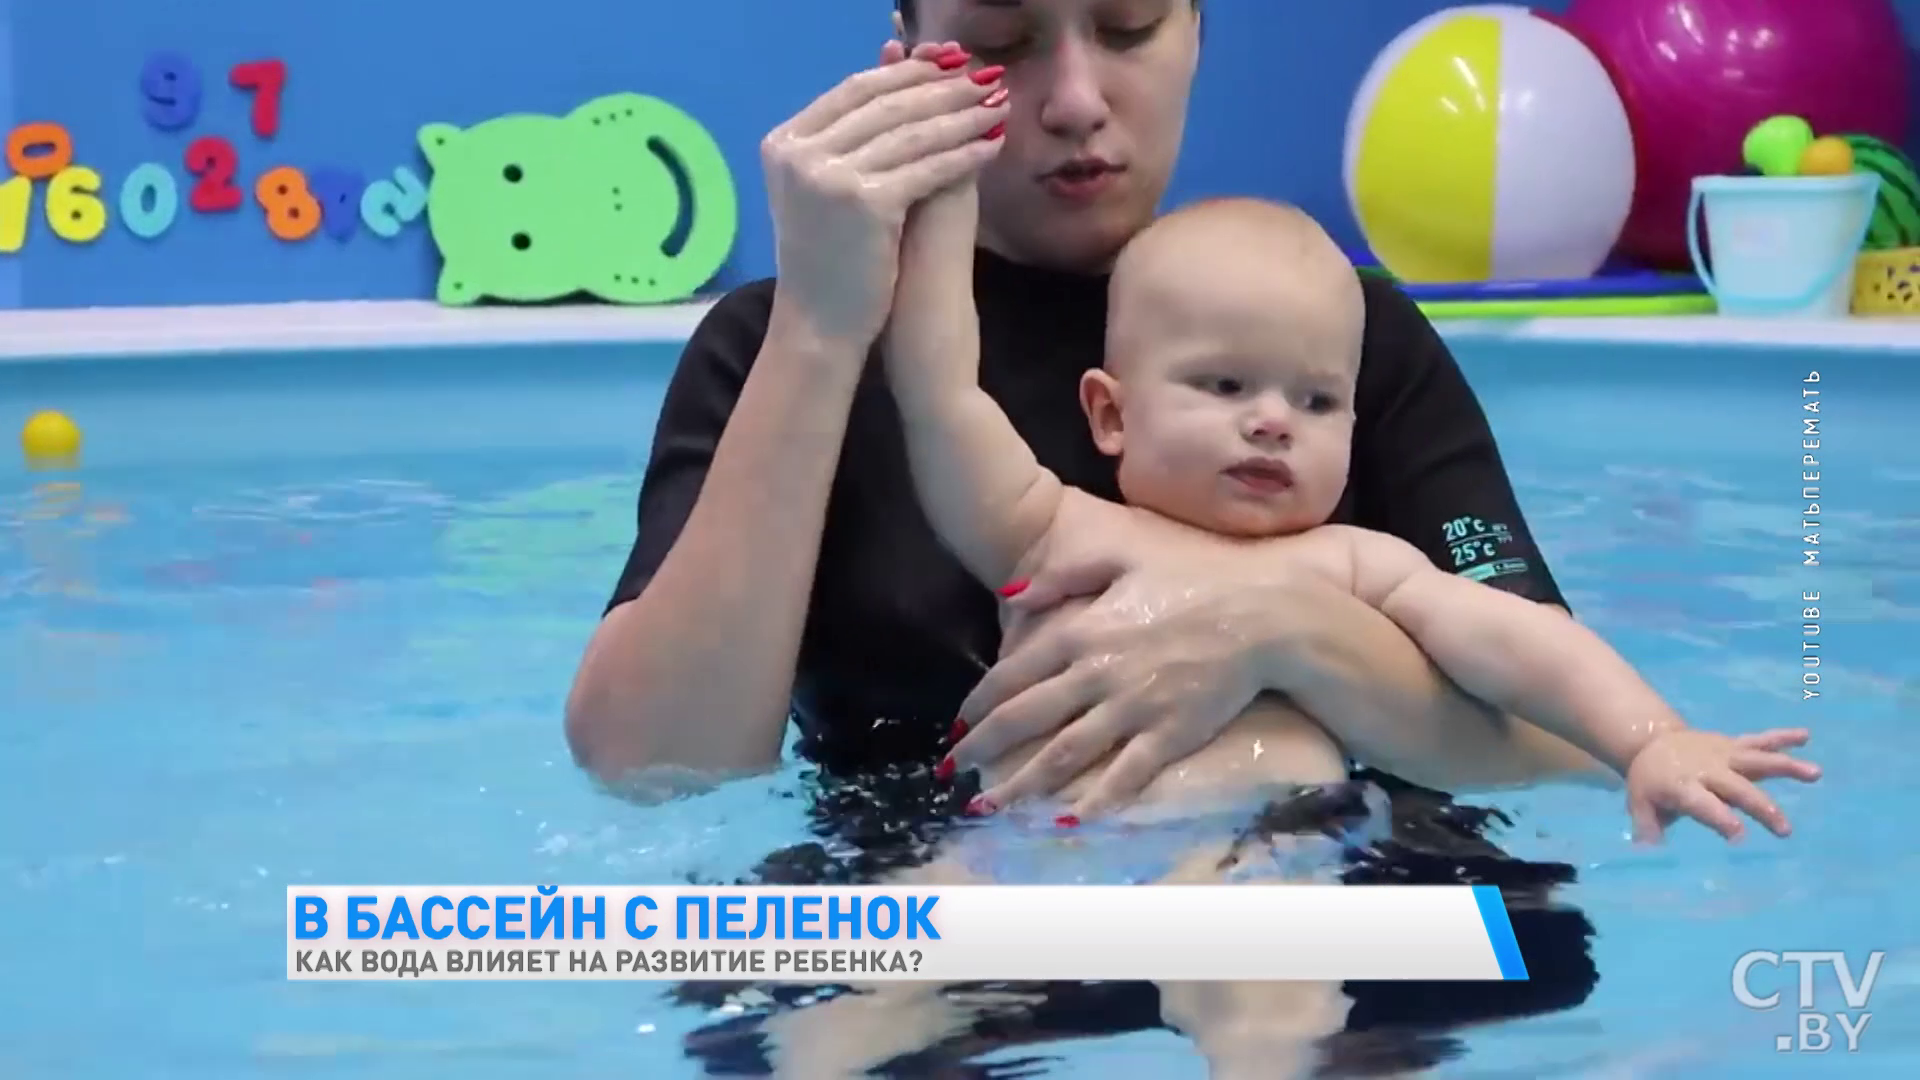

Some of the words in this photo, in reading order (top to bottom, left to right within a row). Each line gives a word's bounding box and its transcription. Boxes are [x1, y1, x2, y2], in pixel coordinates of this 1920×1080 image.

[142, 53, 199, 130] 9
[229, 58, 286, 138] 7
[46, 166, 106, 241] 6
[120, 163, 177, 238] 0
[185, 137, 242, 211] 2
[256, 166, 321, 240] 8
